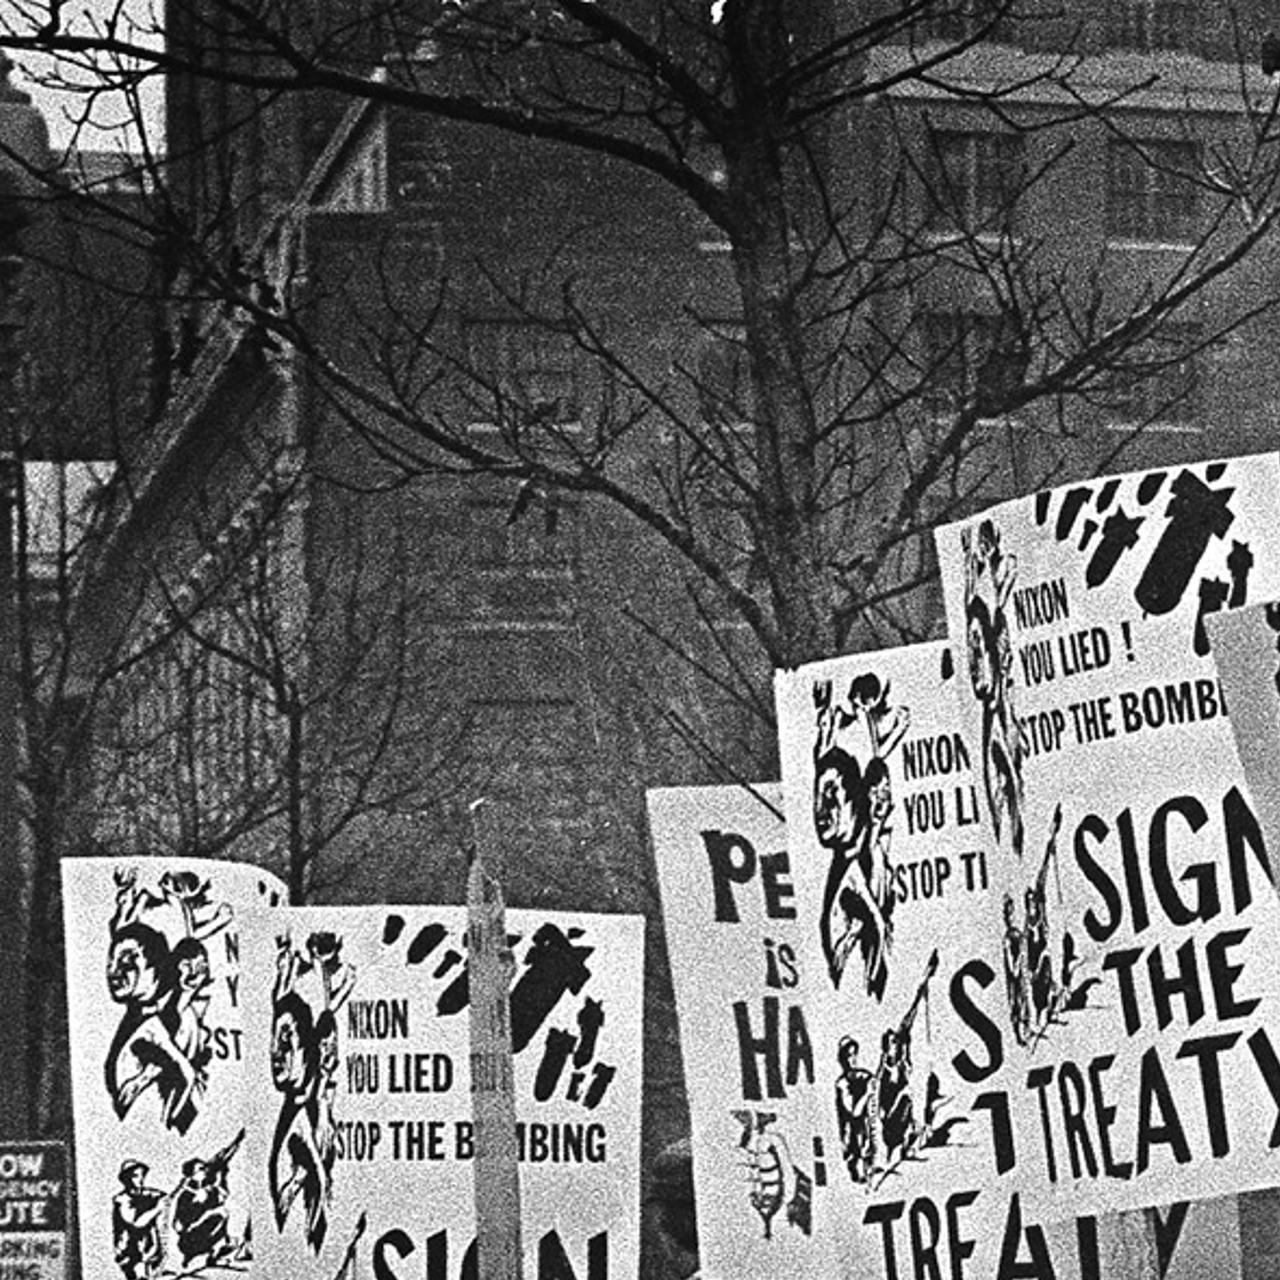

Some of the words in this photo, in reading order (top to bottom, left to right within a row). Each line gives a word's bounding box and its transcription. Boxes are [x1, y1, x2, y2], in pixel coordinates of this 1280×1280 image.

[1013, 577, 1069, 629] NIXON
[1019, 640, 1055, 687] YOU
[1059, 627, 1111, 677] LIED
[1019, 709, 1066, 758] STOP
[1069, 697, 1116, 744] THE
[902, 733, 970, 781] NIXON
[904, 789, 945, 835] YOU
[956, 785, 980, 827] LI
[700, 830, 797, 923] PE
[896, 856, 951, 903] STOP
[1102, 928, 1262, 1037] THE
[214, 1026, 242, 1061] ST
[347, 999, 409, 1040] NIXON
[733, 996, 815, 1100] HA
[346, 1053, 379, 1094] YOU
[388, 1053, 453, 1094] LIED
[336, 1120, 381, 1161] STOP
[388, 1121, 445, 1161] THE
[455, 1121, 607, 1163] BBING
